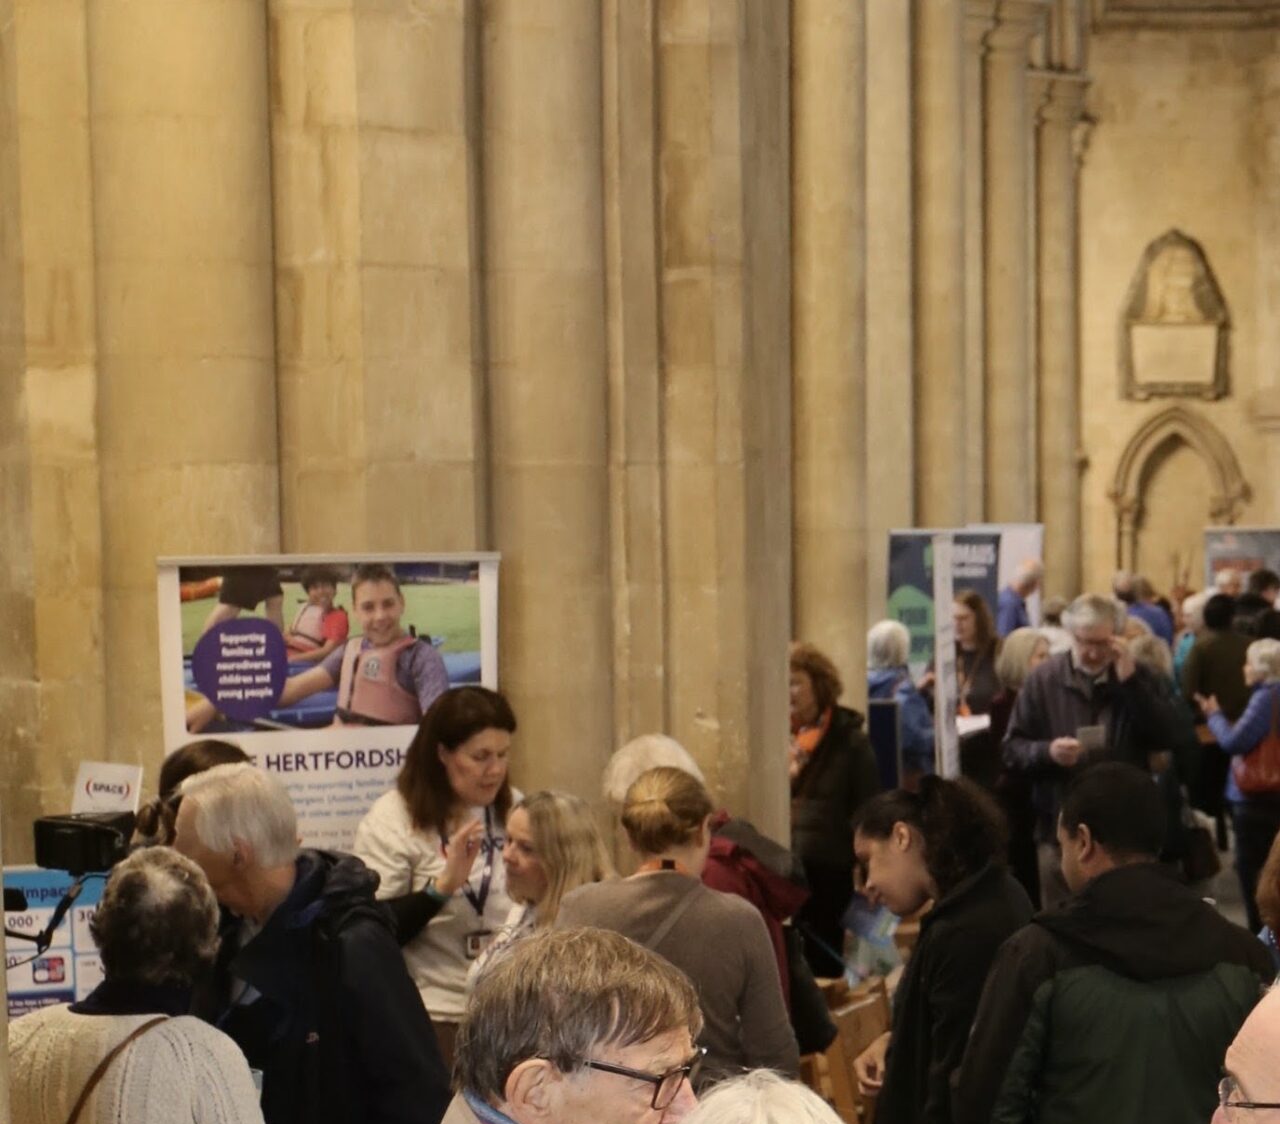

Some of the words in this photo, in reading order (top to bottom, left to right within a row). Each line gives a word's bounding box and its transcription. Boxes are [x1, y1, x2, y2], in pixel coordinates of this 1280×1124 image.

[219, 632, 266, 648] Supporting
[221, 646, 254, 657] families
[216, 660, 272, 671] neurodiverse
[218, 673, 254, 685] children
[255, 672, 271, 684] and
[217, 688, 243, 701] young
[244, 687, 274, 700] people
